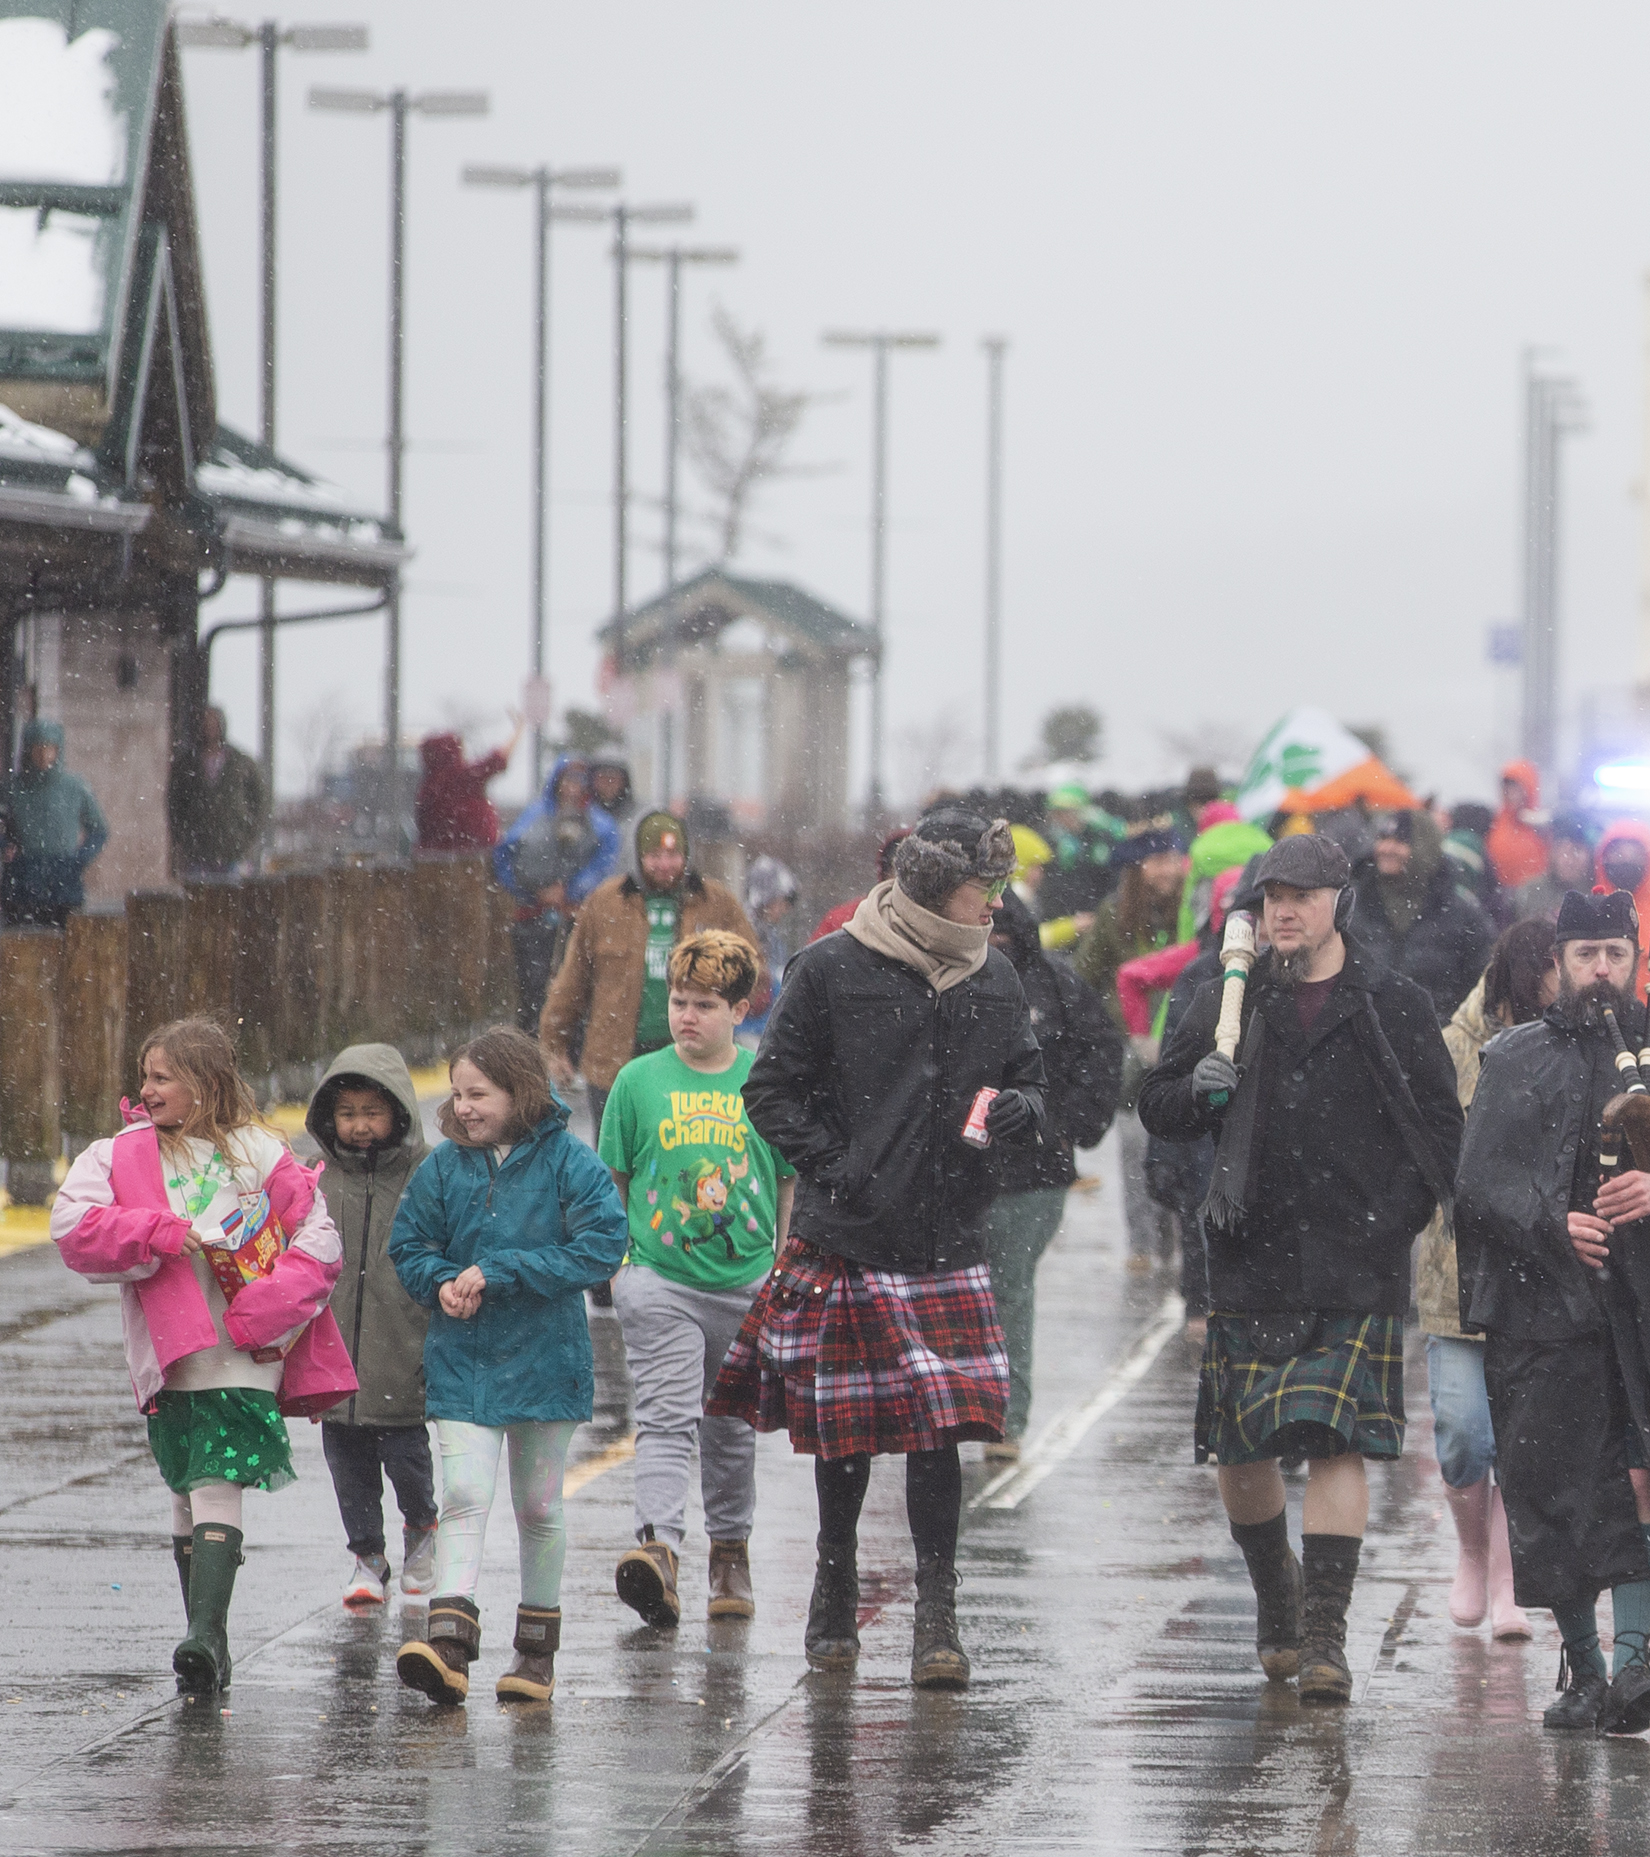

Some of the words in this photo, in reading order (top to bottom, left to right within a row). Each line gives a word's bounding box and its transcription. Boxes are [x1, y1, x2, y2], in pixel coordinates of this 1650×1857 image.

[670, 1091, 744, 1123] Lucky
[659, 1118, 748, 1153] Charms
[178, 1164, 235, 1187] HAPP
